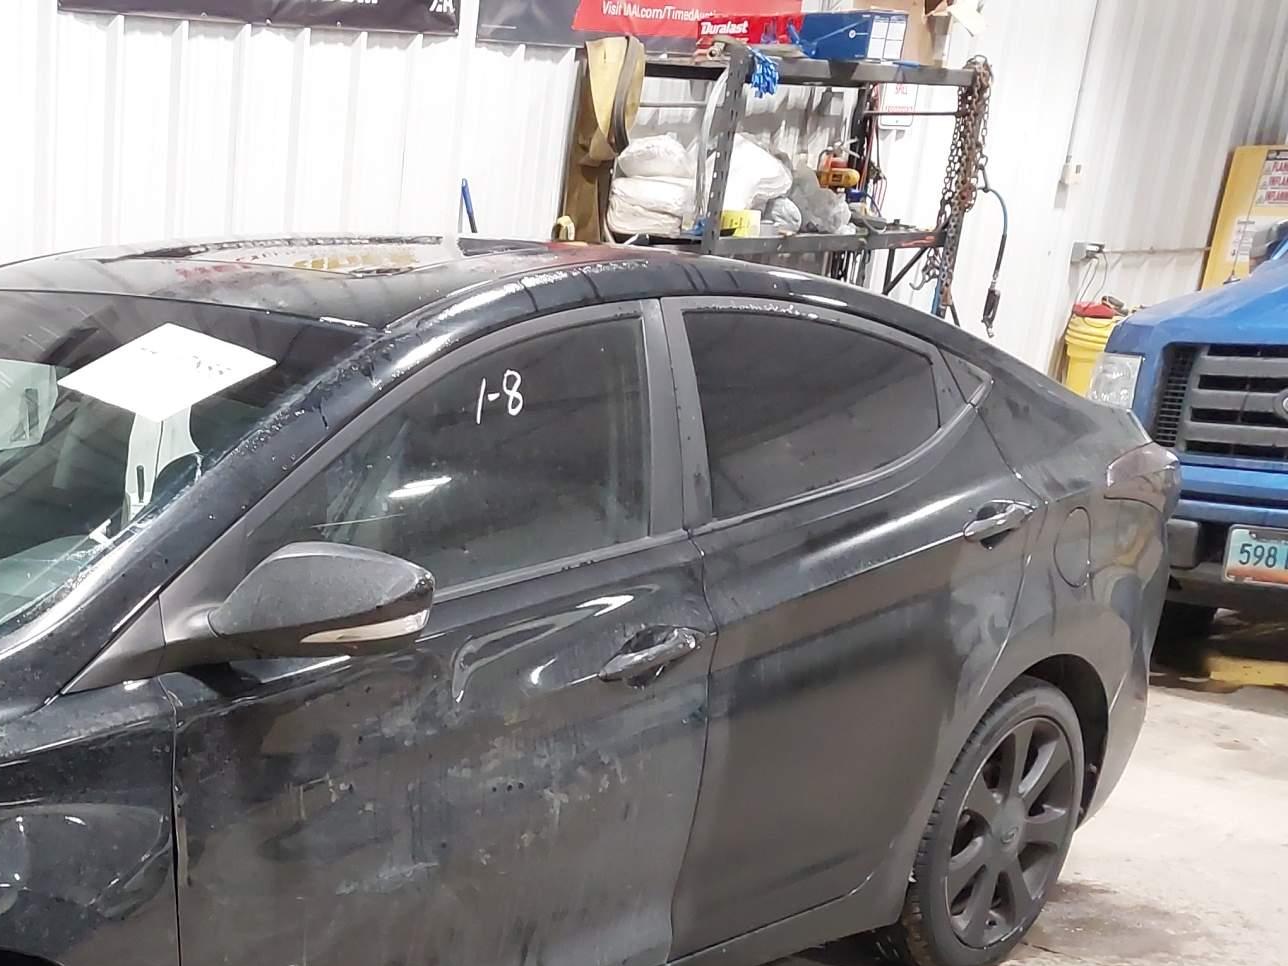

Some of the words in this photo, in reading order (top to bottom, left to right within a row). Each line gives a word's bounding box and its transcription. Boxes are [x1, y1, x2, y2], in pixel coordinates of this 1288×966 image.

[623, 3, 716, 21] IAAI.com/TimedAu
[701, 20, 748, 35] Duralast
[476, 369, 523, 425] 1-8
[1239, 543, 1278, 569] 598
